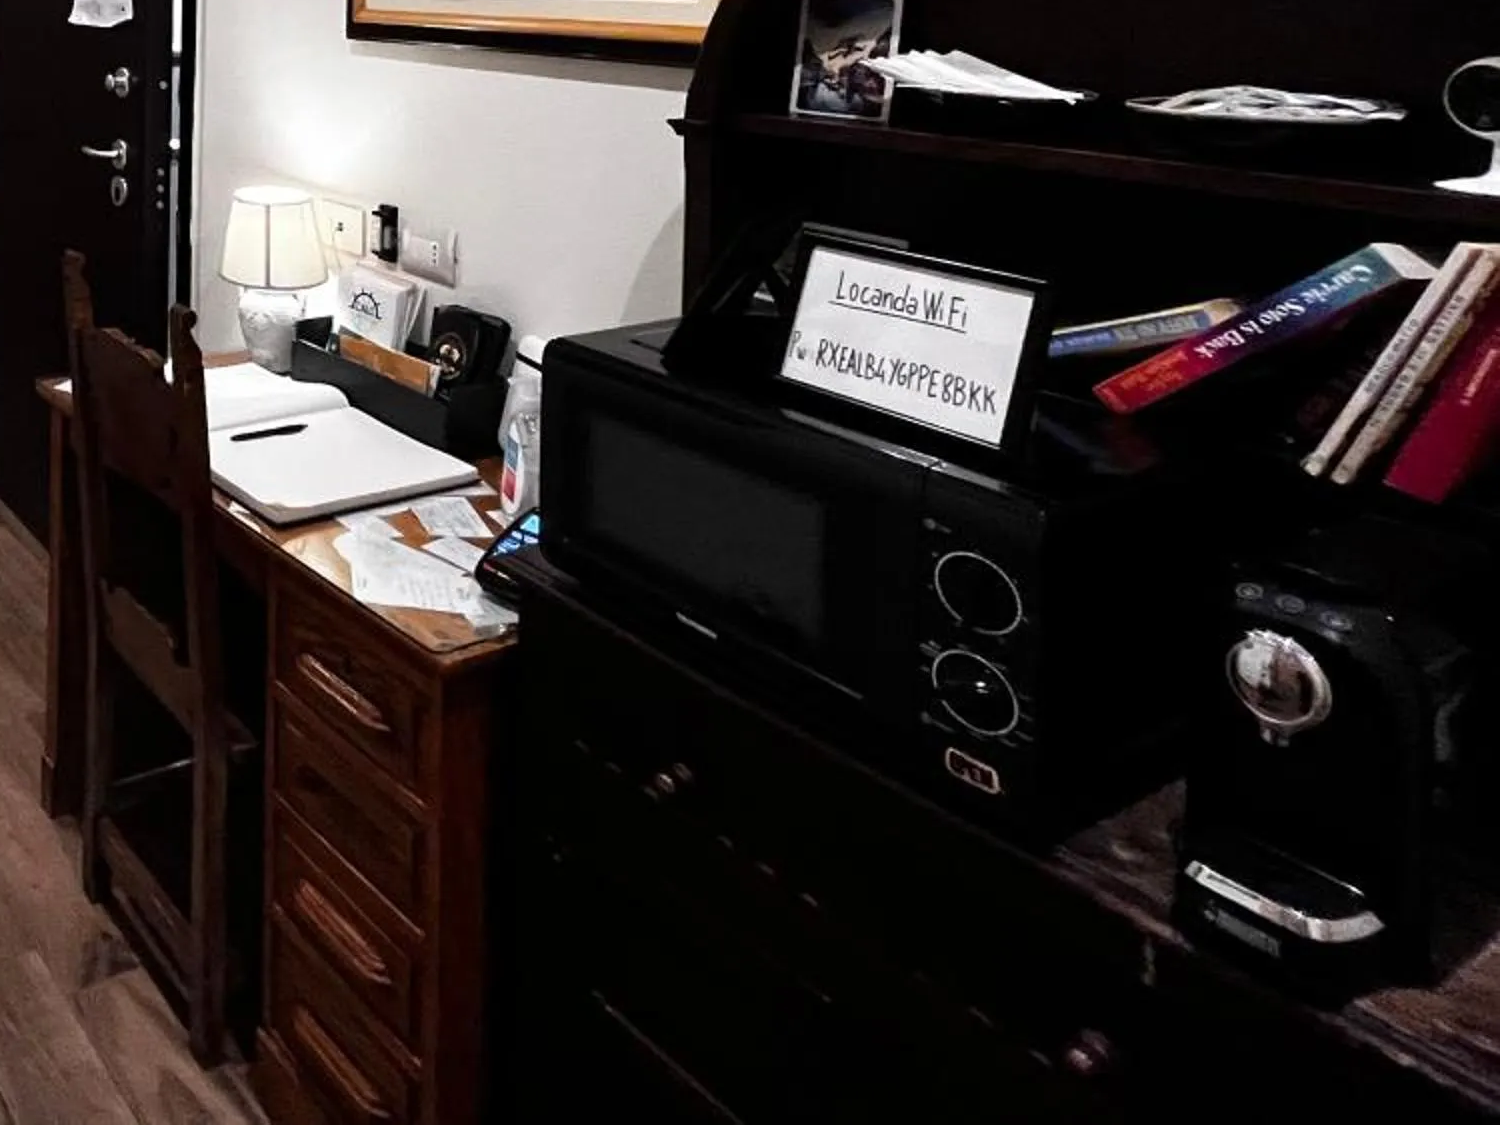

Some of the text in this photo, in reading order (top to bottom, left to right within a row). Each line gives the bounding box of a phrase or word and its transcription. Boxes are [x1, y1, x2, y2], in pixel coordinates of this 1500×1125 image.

[836, 269, 918, 315] Locanda
[1300, 264, 1373, 303] Carrie
[1259, 298, 1306, 325] Soto
[1193, 328, 1245, 358] Back
